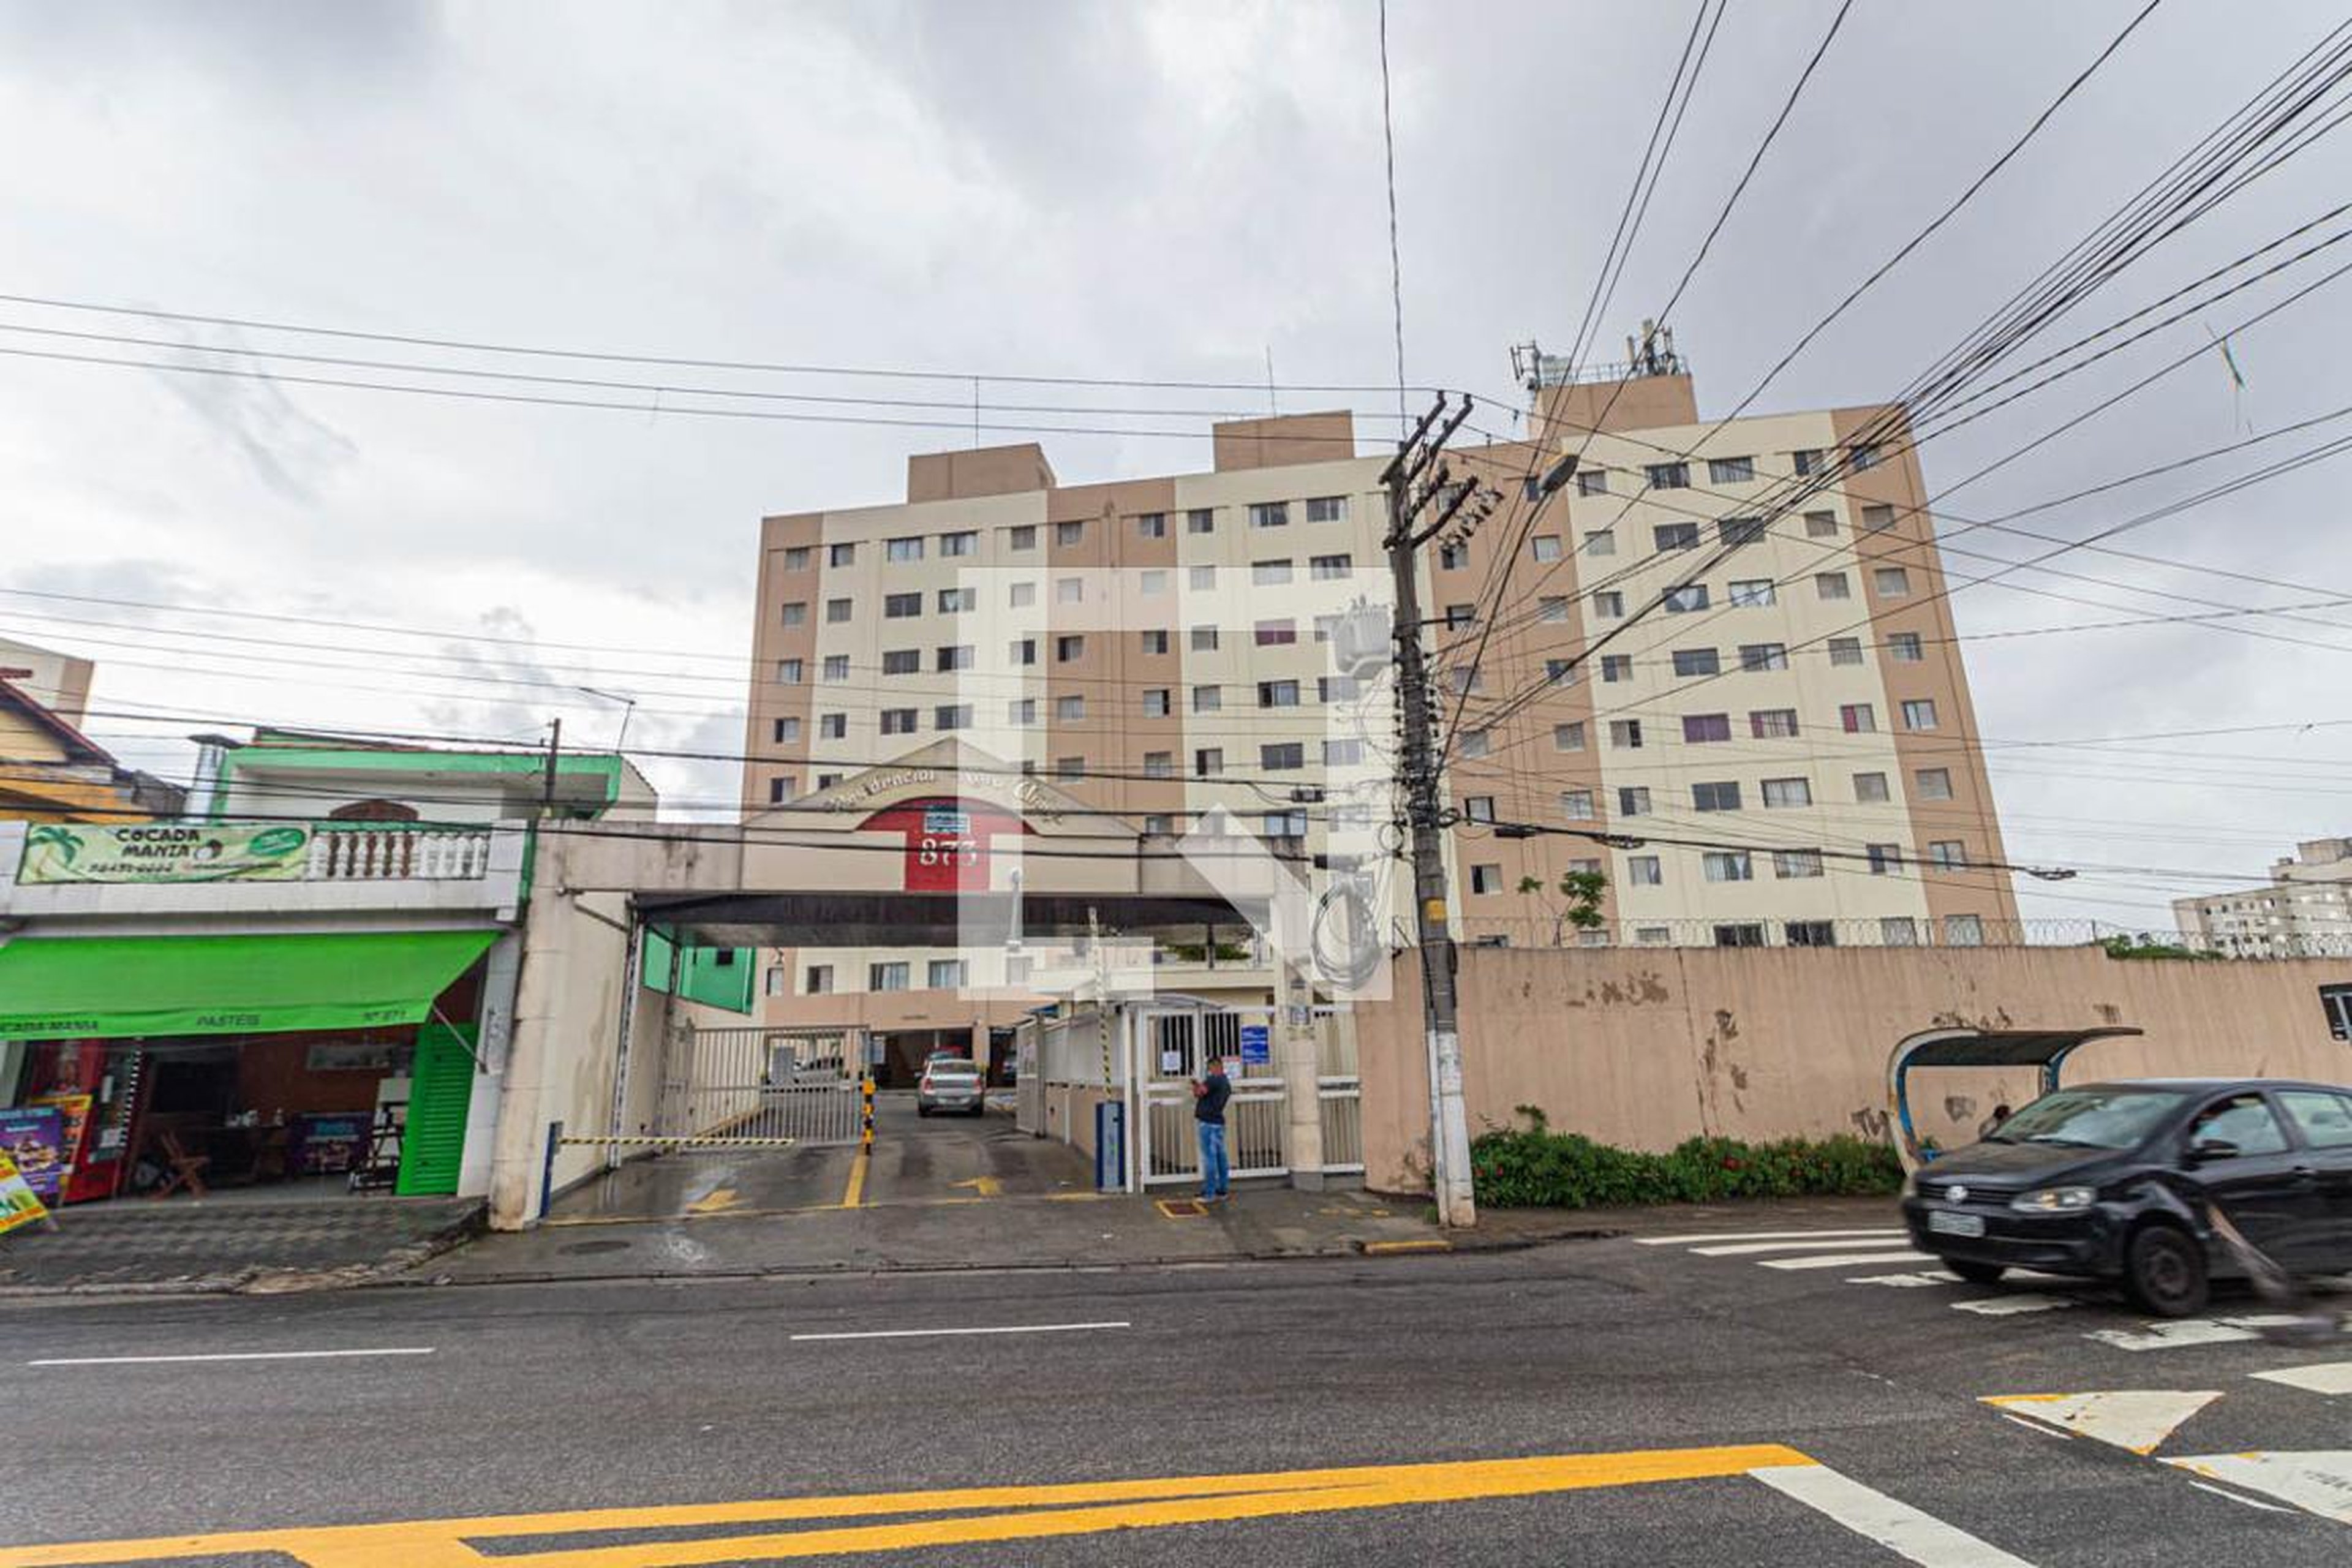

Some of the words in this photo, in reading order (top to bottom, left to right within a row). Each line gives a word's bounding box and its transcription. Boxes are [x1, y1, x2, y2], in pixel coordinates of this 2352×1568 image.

[116, 829, 201, 842] COCADA
[123, 844, 189, 857] MANIA
[920, 839, 978, 867] 873
